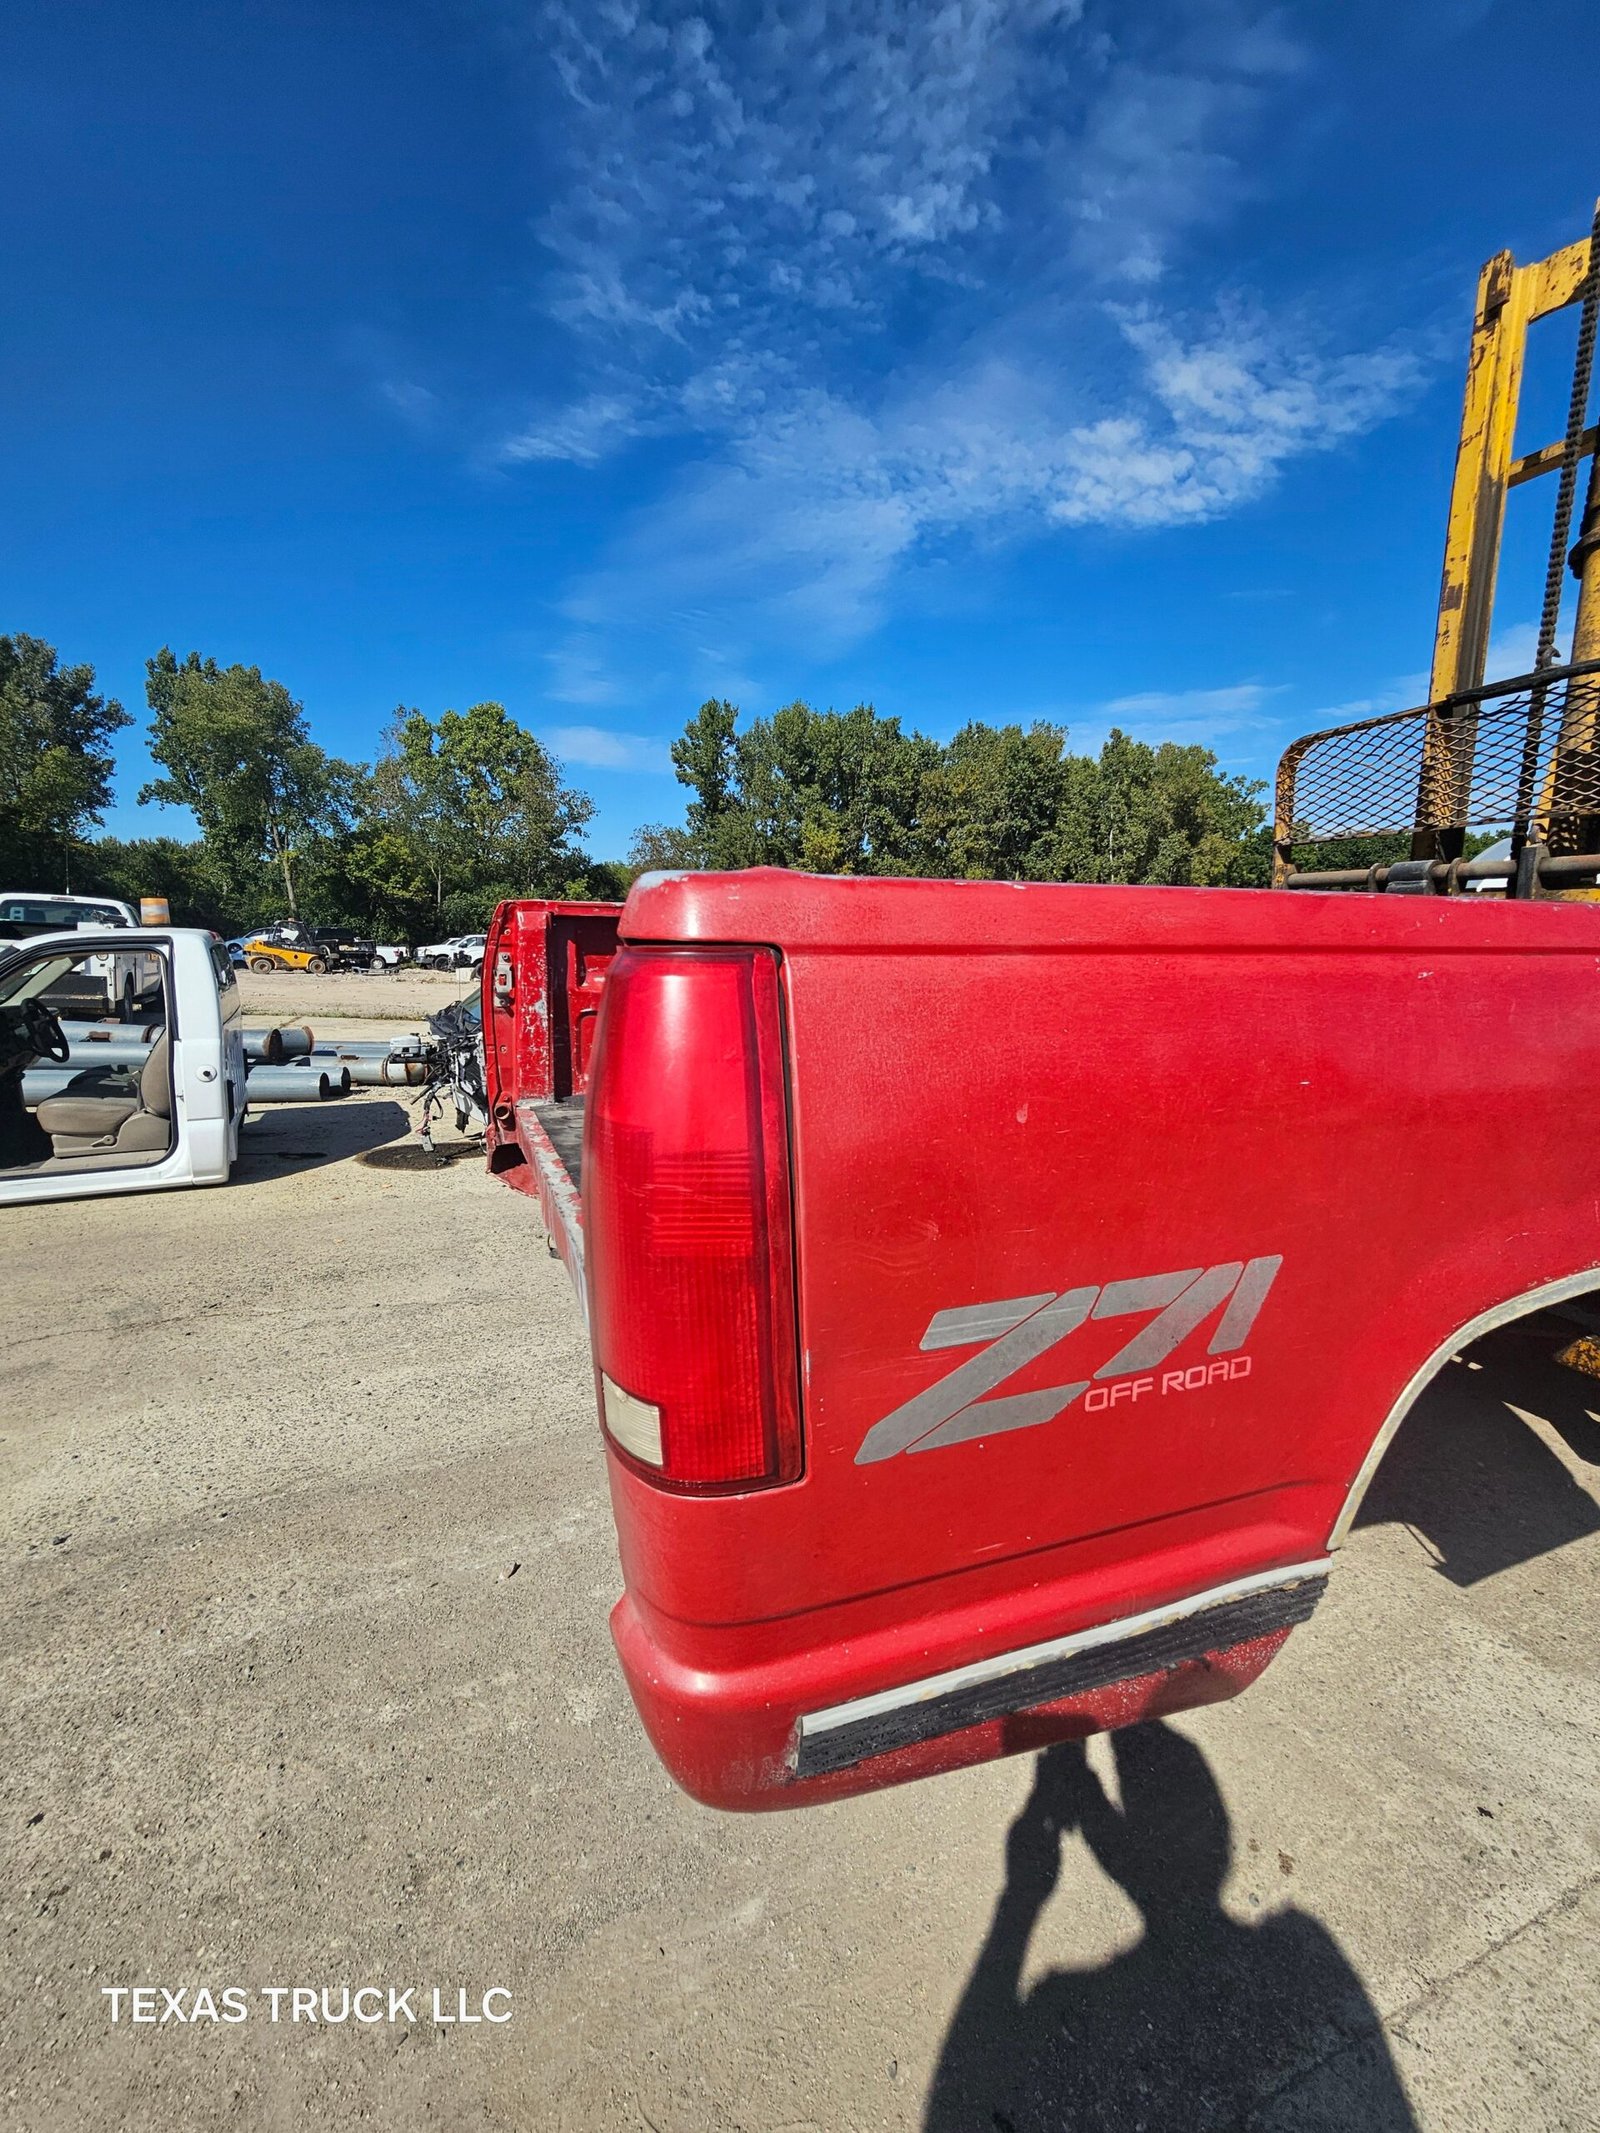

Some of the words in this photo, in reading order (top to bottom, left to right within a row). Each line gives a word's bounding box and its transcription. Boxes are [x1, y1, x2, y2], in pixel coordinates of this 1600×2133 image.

[855, 1254, 1284, 1465] Z71
[1084, 1377, 1154, 1412] OFF
[1161, 1355, 1252, 1395] ROAD
